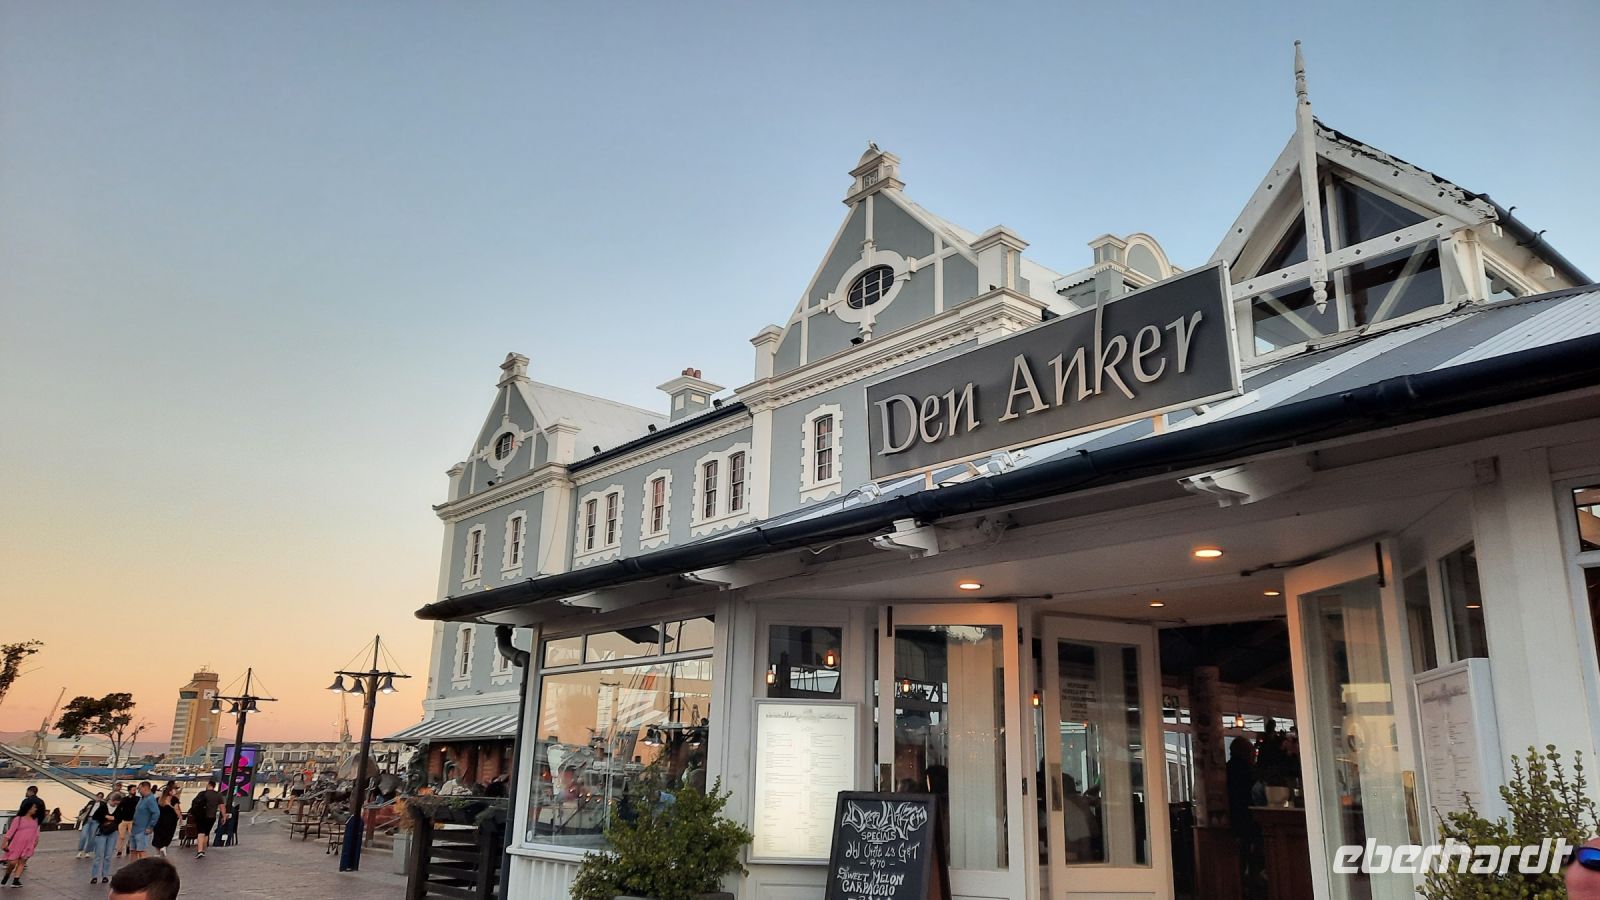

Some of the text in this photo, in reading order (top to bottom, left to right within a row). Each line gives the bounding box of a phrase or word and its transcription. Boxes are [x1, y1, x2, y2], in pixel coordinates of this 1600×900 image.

[874, 289, 1202, 456] Den Anker
[842, 800, 881, 832] Den
[862, 831, 897, 841] SPECIALS
[842, 880, 896, 896] CARPACCIO
